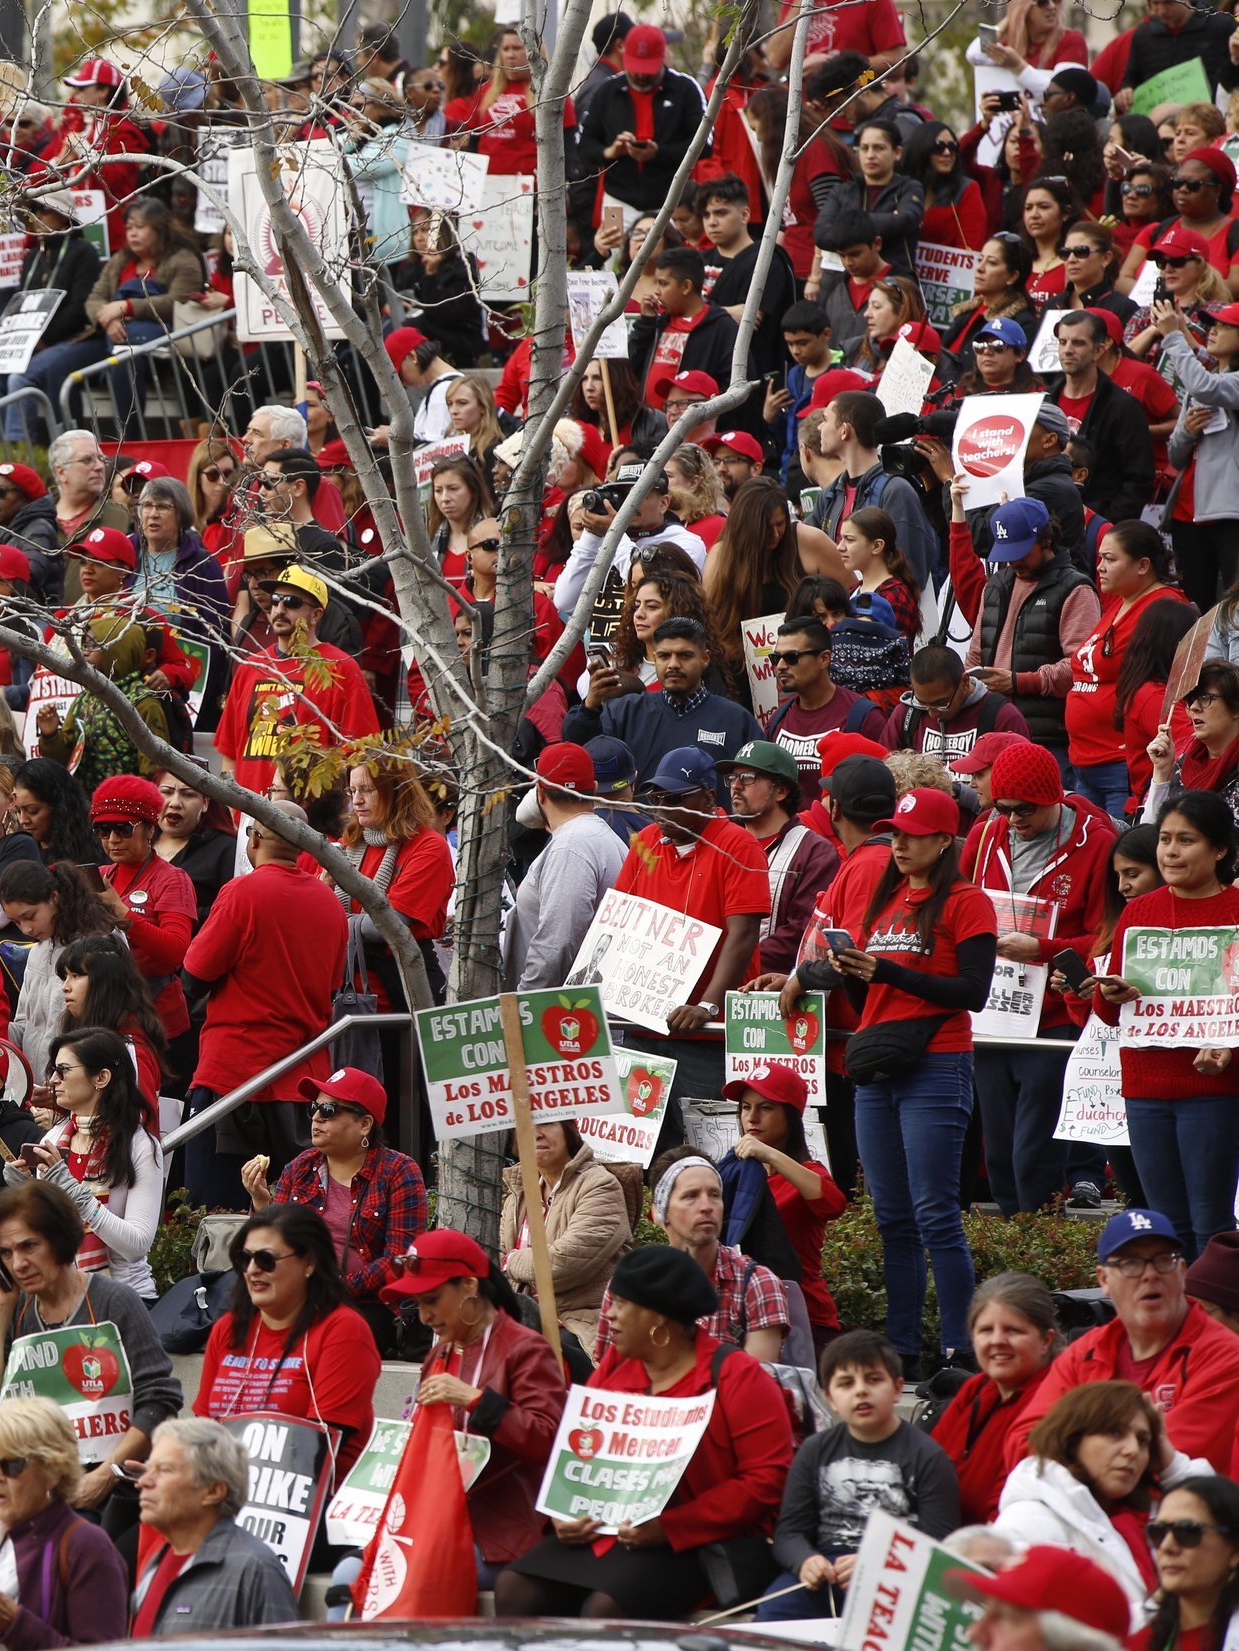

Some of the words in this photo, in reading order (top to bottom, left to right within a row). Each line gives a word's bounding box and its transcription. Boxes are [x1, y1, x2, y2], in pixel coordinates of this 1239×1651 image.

[916, 247, 975, 269] TUDENTS
[916, 266, 951, 283] ERVE
[976, 437, 1004, 449] with
[978, 425, 1014, 438] stand
[962, 442, 1015, 463] teachers!
[591, 621, 620, 637] LIF
[746, 624, 777, 648] We
[779, 736, 822, 758] HOMEBO
[796, 762, 821, 772] STRIES
[598, 893, 704, 957] BEUTNER
[616, 933, 653, 960] NOT
[657, 951, 690, 976] AN
[886, 944, 898, 952] not
[899, 944, 911, 952] for
[911, 945, 930, 955] sae
[1136, 935, 1218, 960] ESTAMOS
[612, 959, 685, 999] HONEST
[994, 965, 1014, 979] OR
[1155, 967, 1192, 991] CON
[731, 998, 784, 1021] ESTAMOS
[1133, 998, 1165, 1017] Los
[1170, 997, 1239, 1017] MAESTR
[430, 1001, 534, 1042] ESTAMS
[1089, 1024, 1121, 1040] DESER
[1127, 1024, 1141, 1038] de
[1143, 1021, 1180, 1038] LOS
[1183, 1020, 1239, 1037] ANGELE
[559, 1040, 581, 1049] UTLA
[743, 1026, 766, 1049] CON
[461, 1039, 507, 1068] CON
[731, 1056, 749, 1072] Los
[442, 1081, 481, 1103] Los
[486, 1060, 603, 1094] MESTROS
[446, 1111, 463, 1126] de
[468, 1098, 508, 1123] LOS
[529, 1084, 611, 1112] NGELES
[1081, 1124, 1107, 1135] FUND
[6, 1341, 59, 1376] TAND
[268, 1356, 303, 1370] STIKE
[82, 1380, 104, 1388] UTLA
[579, 1396, 617, 1422] Los
[623, 1402, 708, 1428] Estudiantes
[74, 1409, 131, 1439] HERS
[242, 1422, 289, 1463] ON
[563, 1460, 650, 1492] CLASES
[247, 1465, 313, 1513] RIKE
[329, 1500, 354, 1521] LA
[883, 1530, 917, 1574] LA
[379, 1551, 397, 1588] WITH
